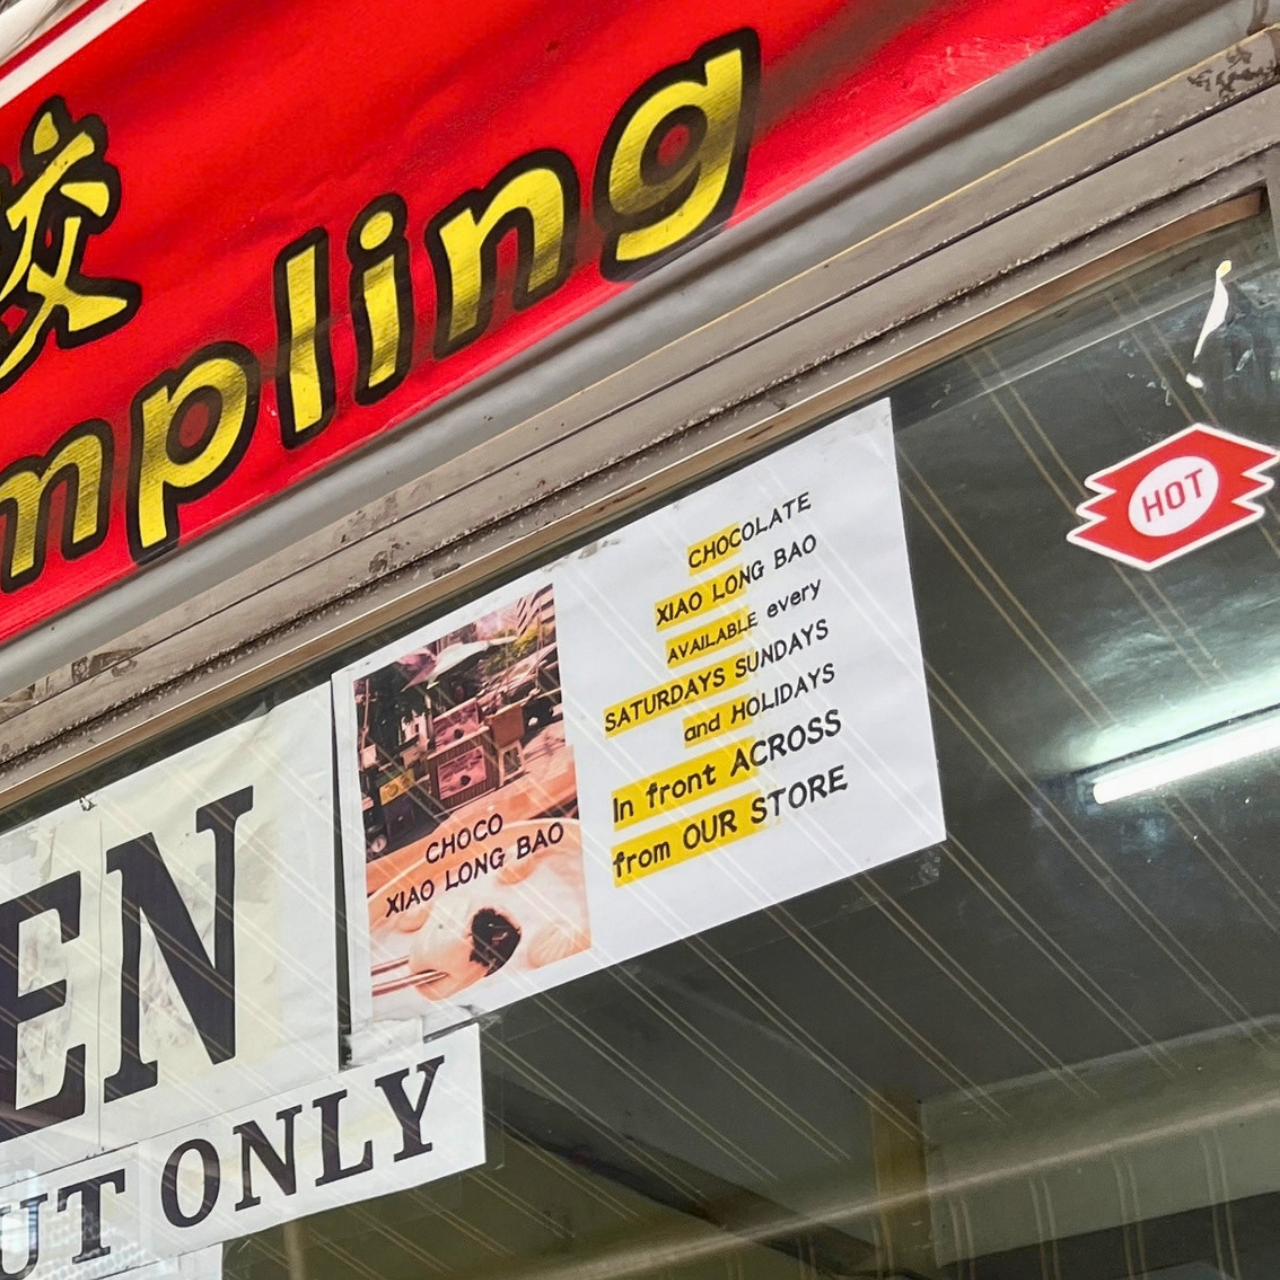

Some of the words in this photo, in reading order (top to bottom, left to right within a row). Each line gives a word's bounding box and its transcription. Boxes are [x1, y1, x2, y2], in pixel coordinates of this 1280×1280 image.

[688, 491, 813, 570] CHOCOLATE
[1142, 469, 1203, 522] HOT
[655, 591, 703, 626] XIAO
[712, 561, 764, 601] LONG
[775, 534, 817, 569] BAO
[667, 612, 758, 664] AVAILABLE
[766, 579, 822, 618] every
[604, 667, 725, 732] SATURDAYS
[735, 619, 829, 679] SUNDAYS
[684, 714, 720, 742] and
[730, 663, 835, 724] HOLIDAYS
[613, 796, 634, 823] In
[646, 762, 716, 805] front
[730, 709, 842, 778] ACROSS
[425, 813, 503, 863] CHOCO
[613, 838, 671, 877] from
[683, 811, 737, 850] OUR
[751, 765, 848, 824] STORE
[385, 879, 435, 917] XIAO
[444, 848, 504, 890] LONG
[516, 822, 564, 861] BAO
[160, 1054, 445, 1228] ONLY
